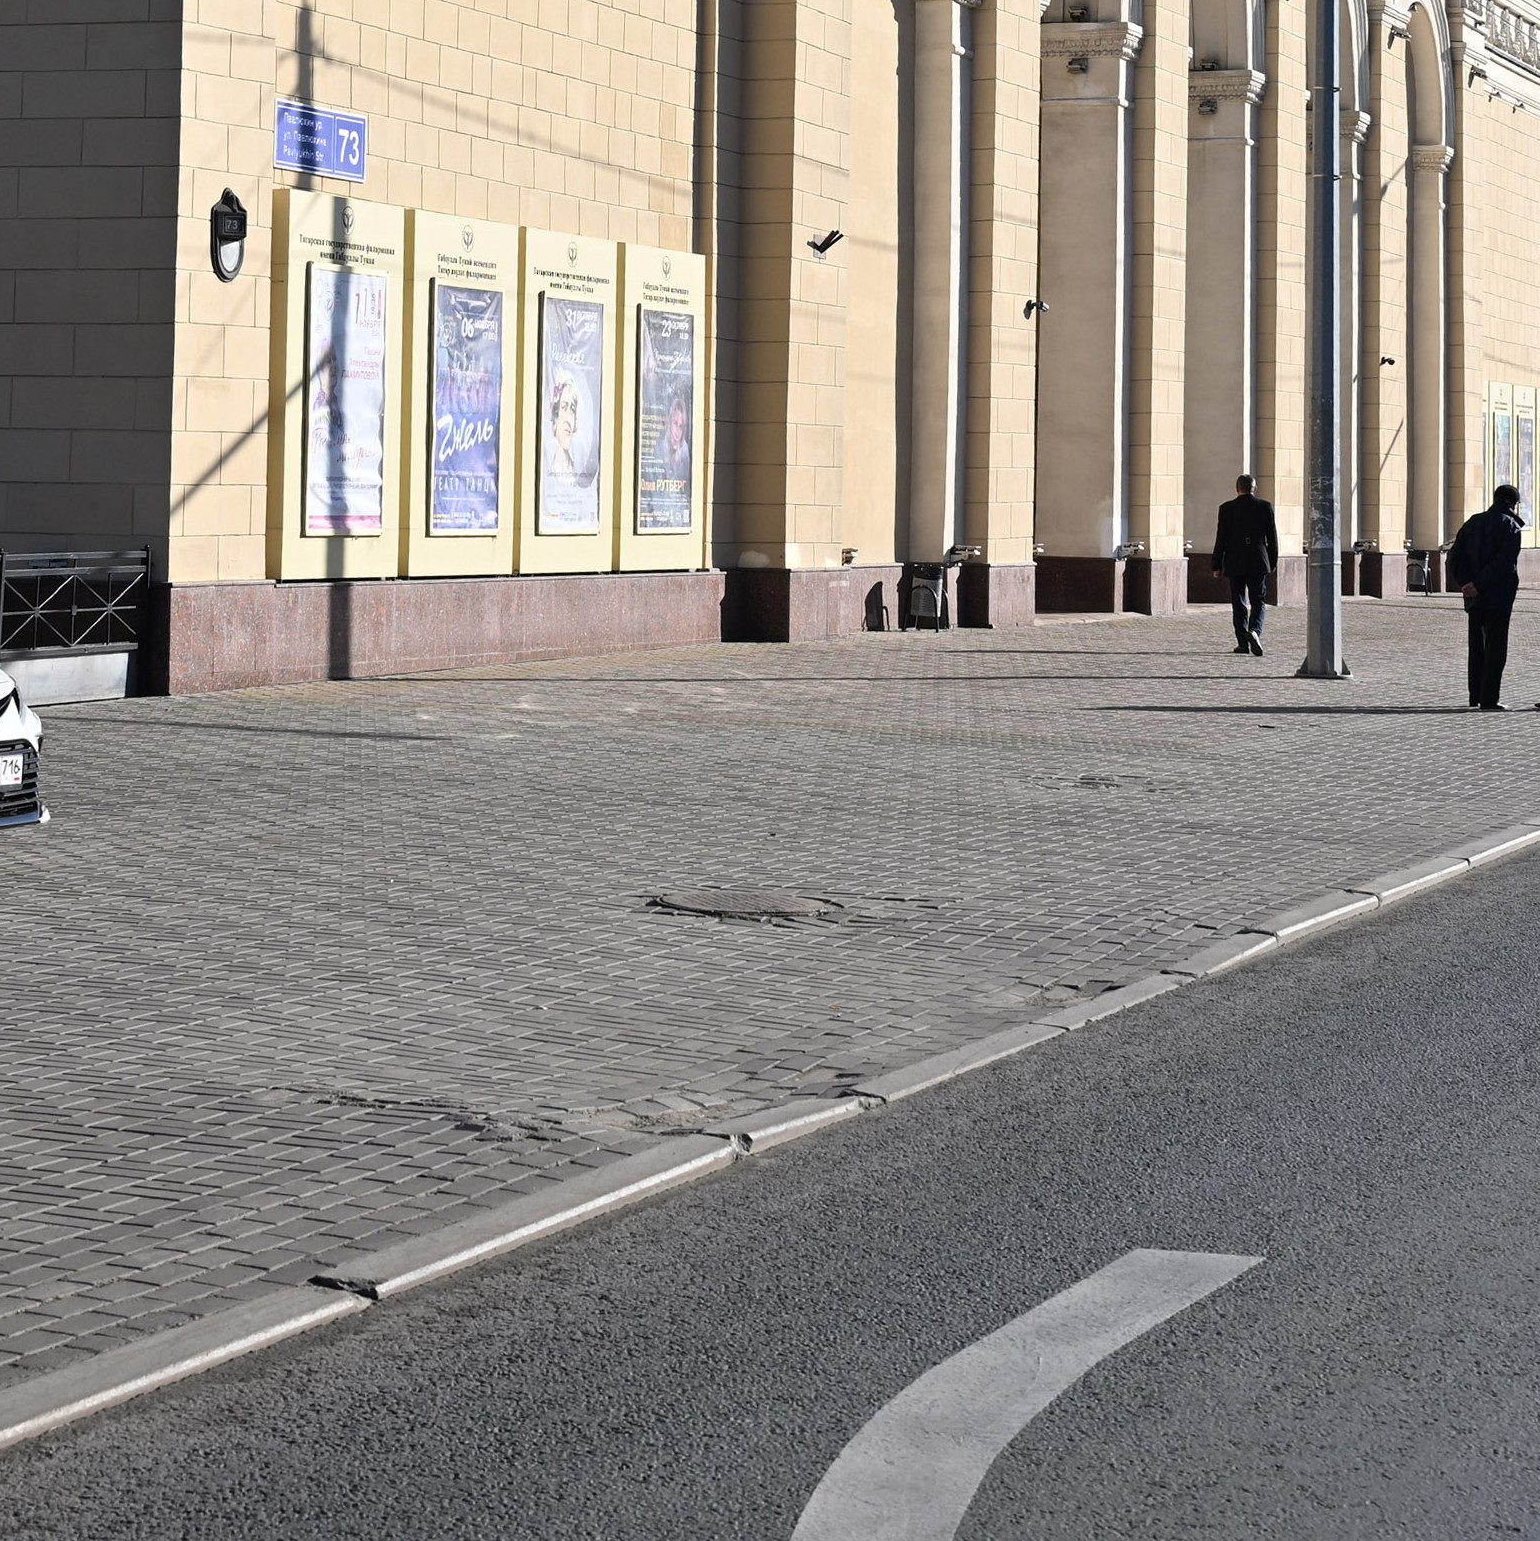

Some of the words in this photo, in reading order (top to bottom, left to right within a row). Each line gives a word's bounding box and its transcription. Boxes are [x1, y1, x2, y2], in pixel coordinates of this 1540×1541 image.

[283, 144, 314, 161] Pavlyukhin
[338, 128, 360, 166] 73
[226, 220, 238, 230] 73
[461, 317, 475, 338] 06
[566, 308, 577, 331] 31
[661, 319, 672, 338] 23
[436, 413, 494, 463] Гжель
[434, 476, 459, 491] ТЕАТР
[656, 479, 687, 492] РУТБЕРГ
[2, 759, 19, 775] 716
